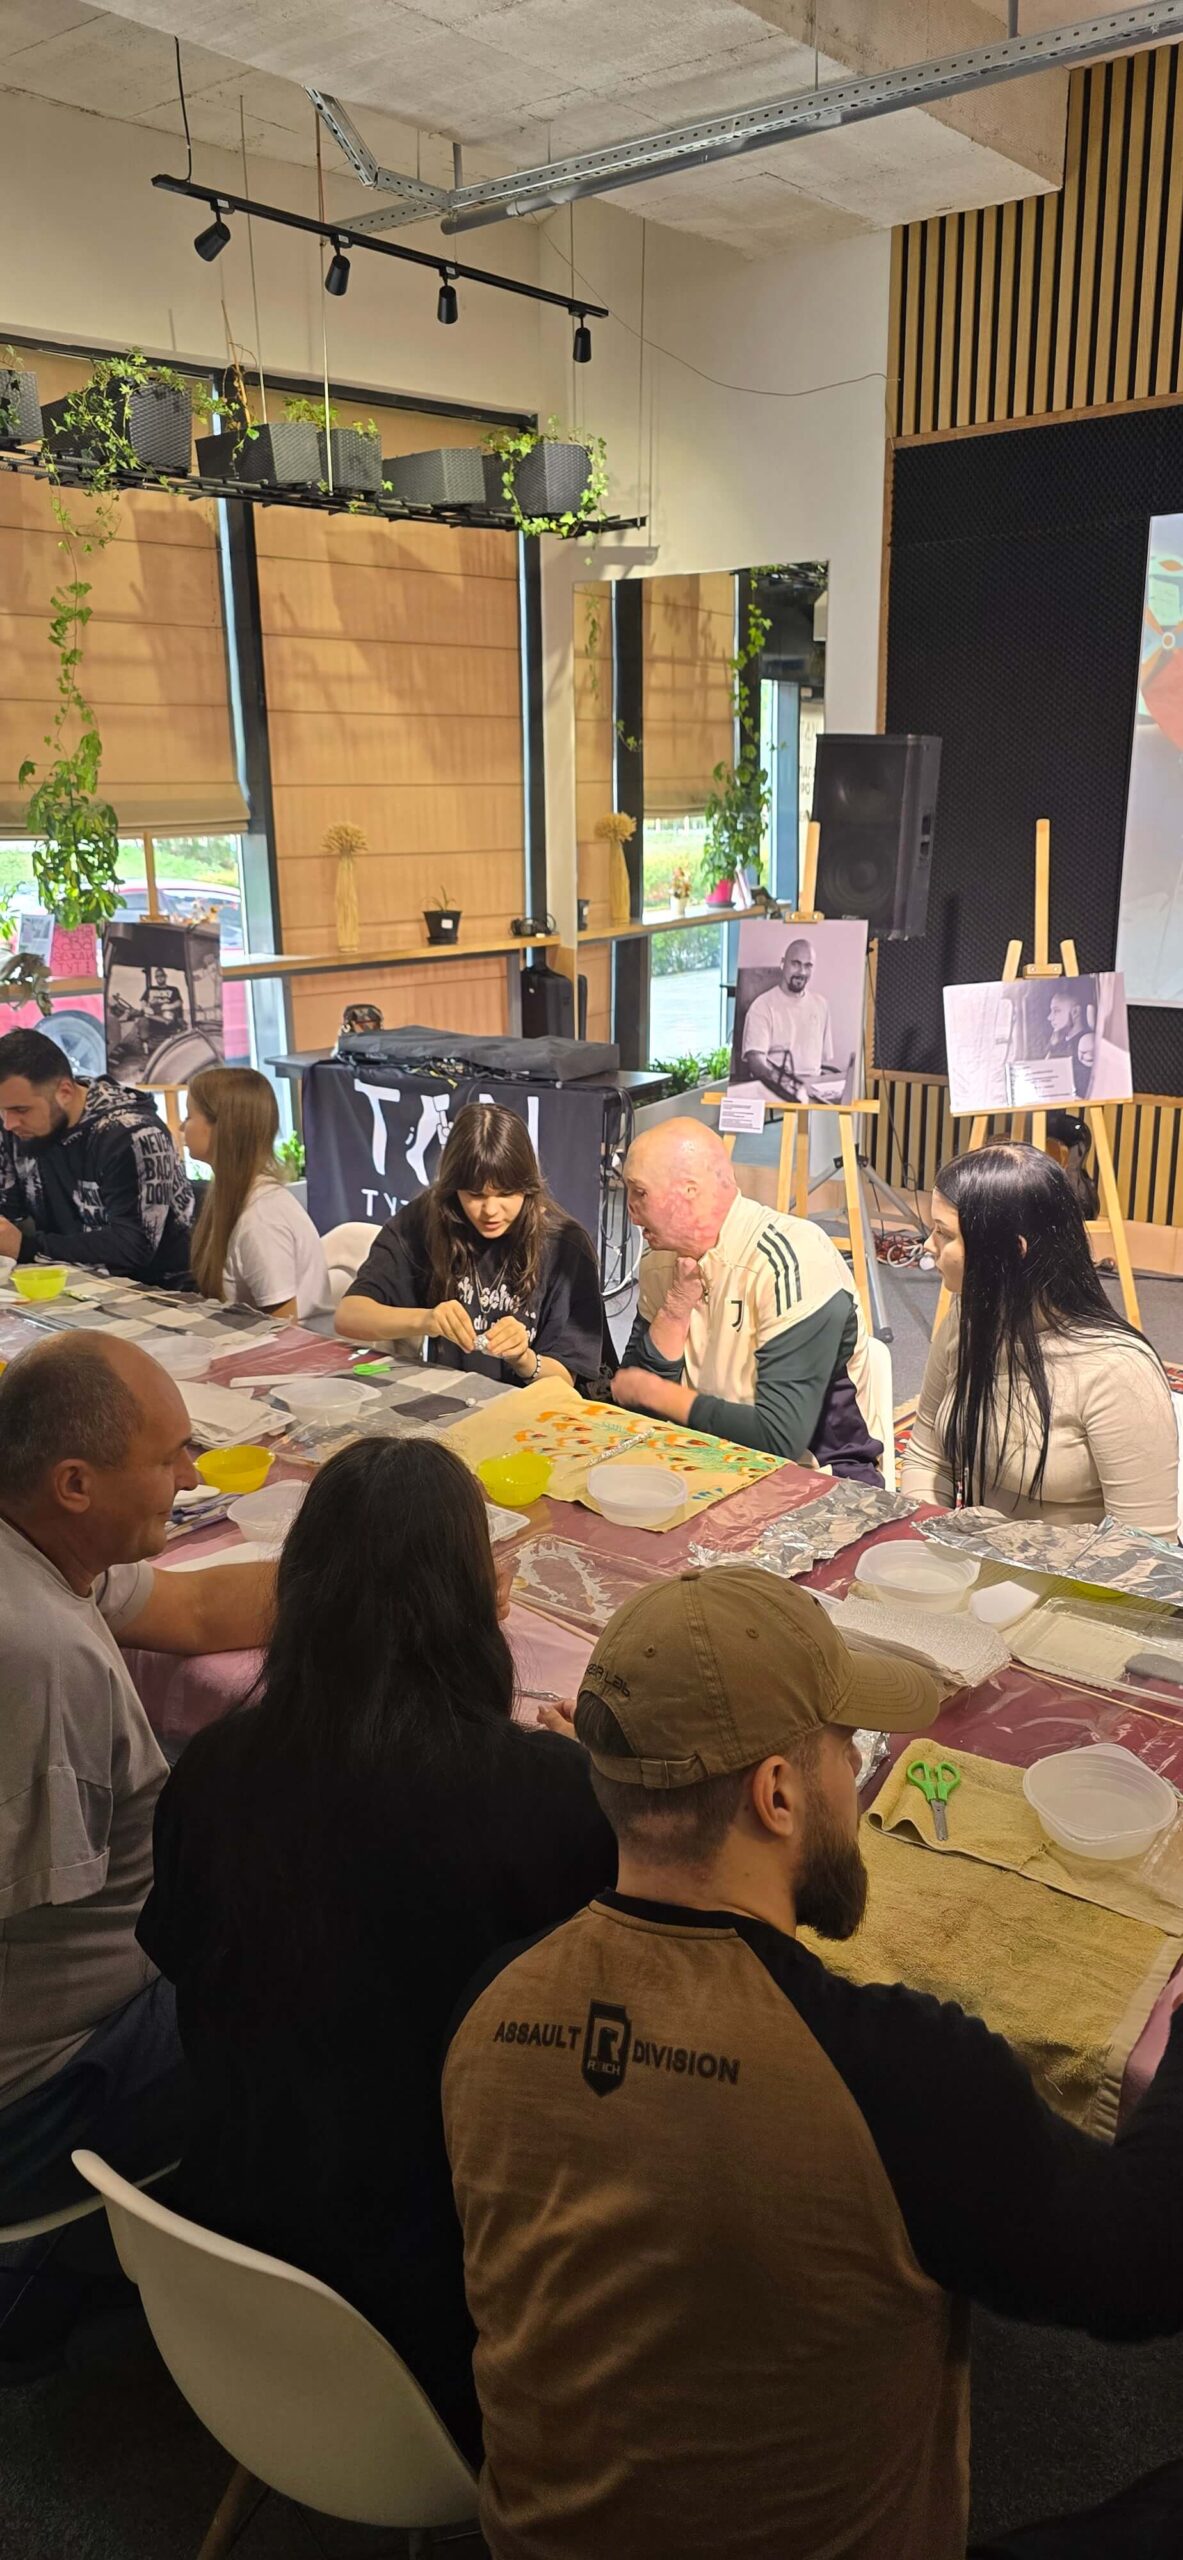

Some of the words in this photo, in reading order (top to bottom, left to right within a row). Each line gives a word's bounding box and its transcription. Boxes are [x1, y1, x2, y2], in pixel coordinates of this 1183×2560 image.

[139, 1132, 172, 1156] NEVE
[146, 1182, 171, 1205] DOW
[361, 1188, 408, 1217] TY
[493, 2020, 582, 2051] ASSAULT
[631, 2038, 741, 2085] DIVISION
